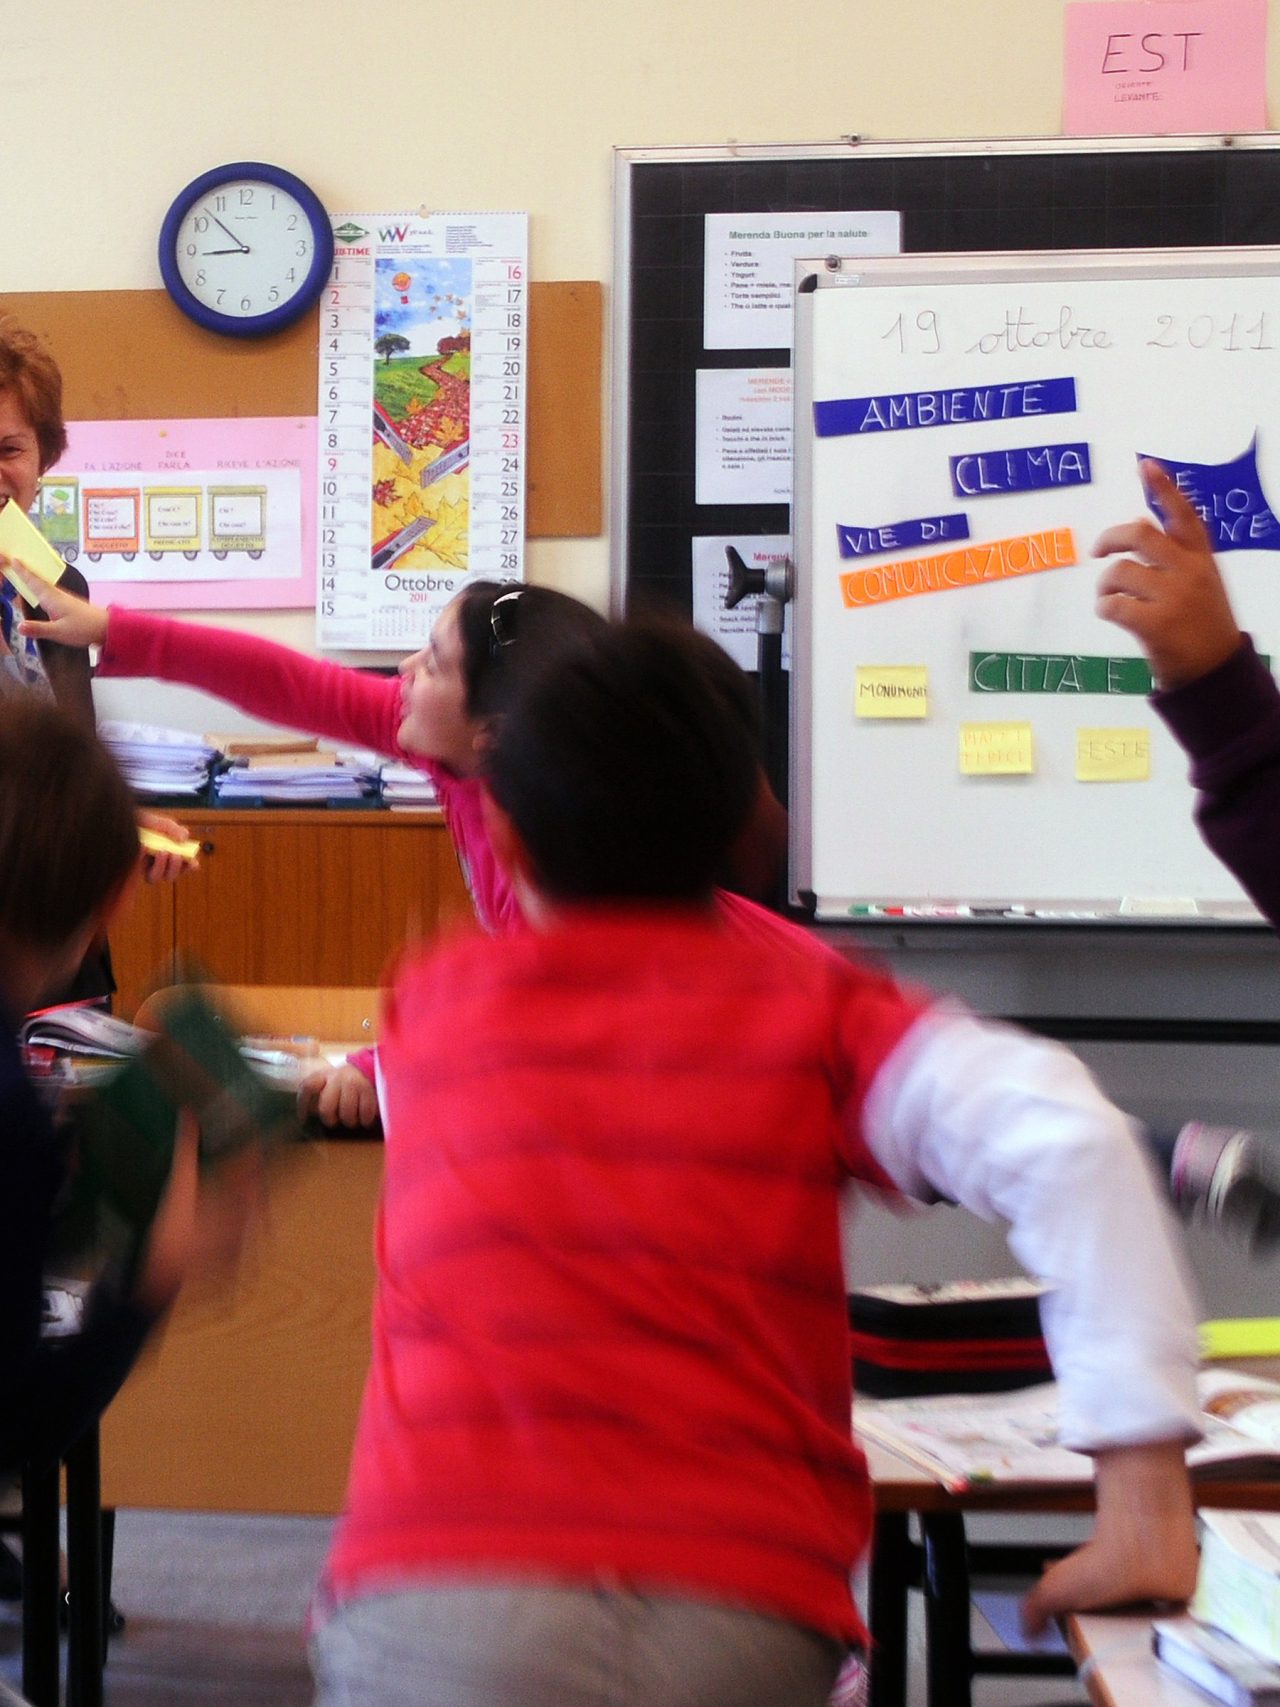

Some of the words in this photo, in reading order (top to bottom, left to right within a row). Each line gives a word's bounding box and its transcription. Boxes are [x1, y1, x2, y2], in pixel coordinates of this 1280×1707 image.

[1101, 32, 1203, 74] EST
[216, 195, 226, 212] 11
[239, 189, 254, 205] 12
[271, 194, 276, 211] 1
[193, 216, 209, 233] 10
[287, 214, 298, 231] 2
[729, 230, 771, 239] Merenda
[773, 230, 805, 239] Buona
[807, 231, 823, 240] per
[826, 230, 835, 238] la
[838, 229, 868, 238] salute
[186, 243, 197, 258] 9
[296, 240, 306, 257] 3
[195, 268, 206, 286] 8
[285, 267, 295, 283] 4
[334, 266, 339, 280] 1
[507, 265, 522, 280] 16
[216, 289, 227, 305] 7
[268, 286, 280, 303] 5
[330, 290, 340, 305] 2
[507, 289, 521, 304] 17
[240, 295, 251, 311] 6
[330, 314, 339, 329] 3
[506, 313, 521, 328] 18
[881, 310, 941, 354] 19
[965, 305, 1114, 355] ottobre
[1146, 311, 1275, 353] 2011
[329, 338, 338, 352] 4
[506, 337, 520, 352] 19
[329, 362, 338, 376] 5
[503, 361, 520, 376] 20
[328, 386, 338, 400] 6
[503, 386, 519, 400] 21
[859, 383, 1047, 433] AMBIENTE
[329, 410, 338, 424] 7
[502, 409, 519, 424] 22
[328, 434, 337, 448] 8
[501, 434, 519, 448] 23
[327, 458, 337, 472] 9
[501, 458, 518, 472] 24
[954, 448, 1087, 496] CLIMA
[322, 482, 337, 496] 10
[500, 482, 518, 497] 25
[322, 506, 335, 520] 11
[500, 505, 518, 520] 26
[1219, 508, 1275, 541] NE
[322, 529, 336, 544] 12
[500, 529, 518, 544] 27
[844, 527, 899, 554] VIE
[920, 521, 947, 541] DI
[322, 554, 336, 568] 13
[500, 553, 518, 568] 28
[846, 530, 1077, 604] COMUNICAZIONE
[321, 577, 336, 591] 14
[384, 573, 454, 591] Ottobre
[321, 601, 335, 616] 15
[1106, 656, 1127, 694] E
